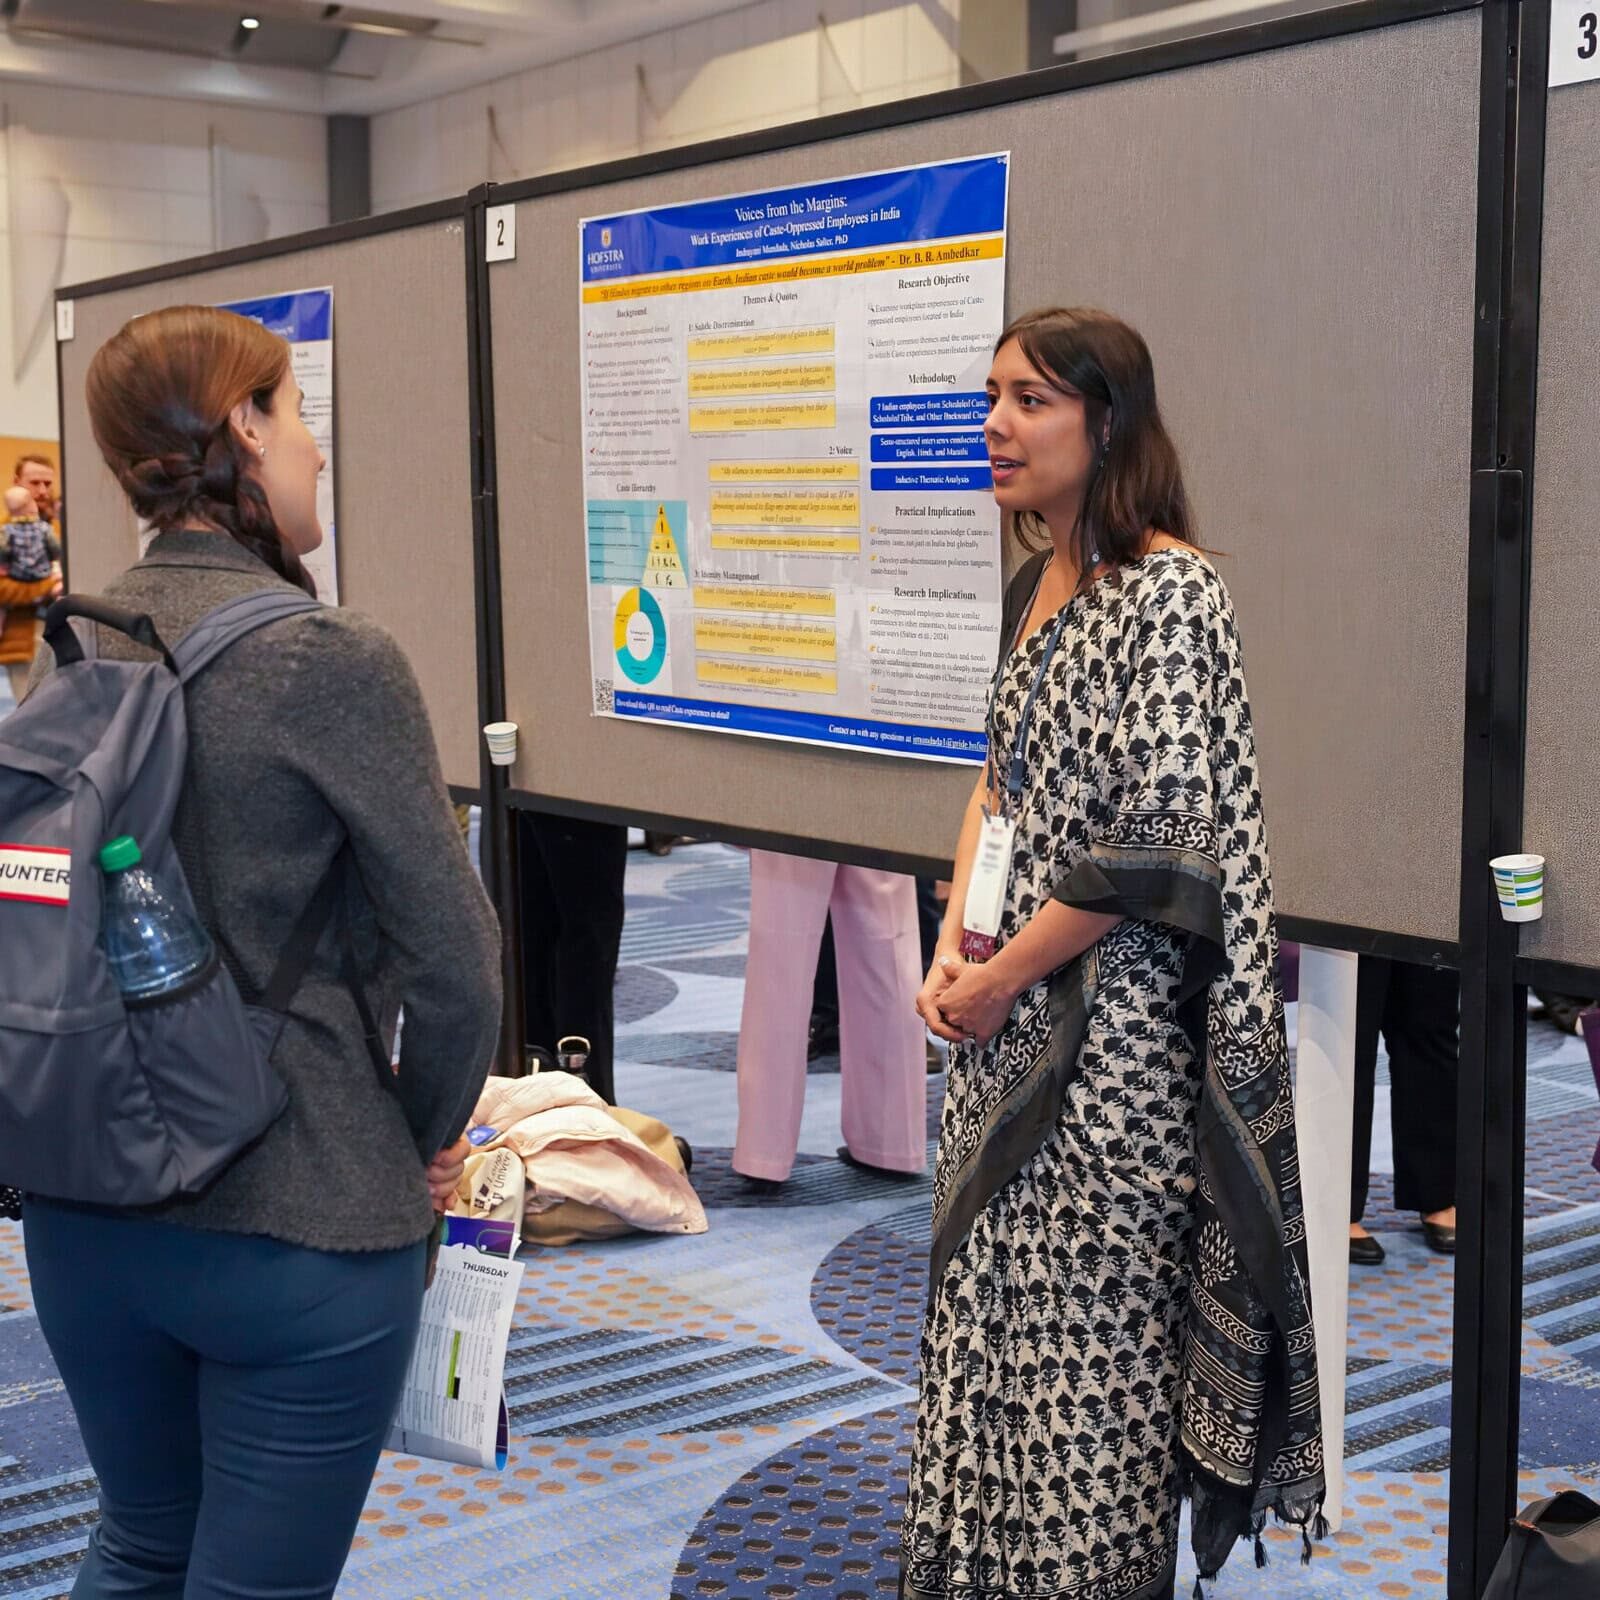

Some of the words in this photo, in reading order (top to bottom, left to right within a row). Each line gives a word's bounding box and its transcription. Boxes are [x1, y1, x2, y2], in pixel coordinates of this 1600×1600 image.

[1577, 12, 1598, 60] 3
[735, 204, 765, 222] Voices
[766, 201, 788, 218] from
[790, 199, 804, 214] the
[806, 193, 848, 216] Margins:
[497, 218, 504, 246] 2
[690, 232, 709, 246] Work
[710, 226, 753, 246] Experiences
[763, 217, 825, 239] Caste-Oppressed
[826, 211, 869, 230] Employees
[880, 206, 900, 220] India
[790, 238, 815, 251] Nicholas
[834, 234, 848, 245] PhD
[587, 248, 624, 265] HOFSTRA
[735, 271, 758, 283] Indian
[758, 270, 774, 281] caste
[776, 267, 798, 279] would
[799, 264, 824, 276] become
[832, 260, 854, 273] world
[899, 254, 912, 265] Dr.
[936, 246, 980, 261] Ambedkar
[898, 276, 932, 289] Research
[933, 273, 970, 288] Objective
[743, 294, 766, 305] Themes
[775, 291, 798, 302] Quotes
[616, 307, 647, 318] Background
[713, 318, 755, 330] Discrimination
[909, 372, 956, 384] Methodology
[882, 402, 899, 411] Indian
[898, 401, 926, 412] employees
[926, 401, 940, 409] from
[941, 399, 971, 409] Scheduled
[872, 414, 900, 422] Scheduled
[926, 412, 943, 421] Other
[943, 411, 972, 420] Backward
[836, 445, 853, 455] Voice
[895, 475, 919, 484] Inductive
[919, 475, 944, 484] Thematic
[945, 474, 970, 486] Analysis
[616, 483, 631, 492] Caste
[631, 483, 657, 494] Hierarchy
[895, 506, 926, 516] Practical
[928, 506, 976, 519] Implications
[931, 539, 945, 548] India
[957, 540, 979, 550] globally
[722, 571, 760, 582] Management
[894, 586, 926, 598] Research
[928, 588, 977, 602] Implications
[616, 698, 639, 709] Download
[672, 705, 684, 714] Caste
[716, 710, 730, 720] detail
[828, 724, 849, 735] Contact
[856, 727, 869, 738] with
[880, 730, 905, 744] questions
[462, 1262, 509, 1278] THURSDAY
